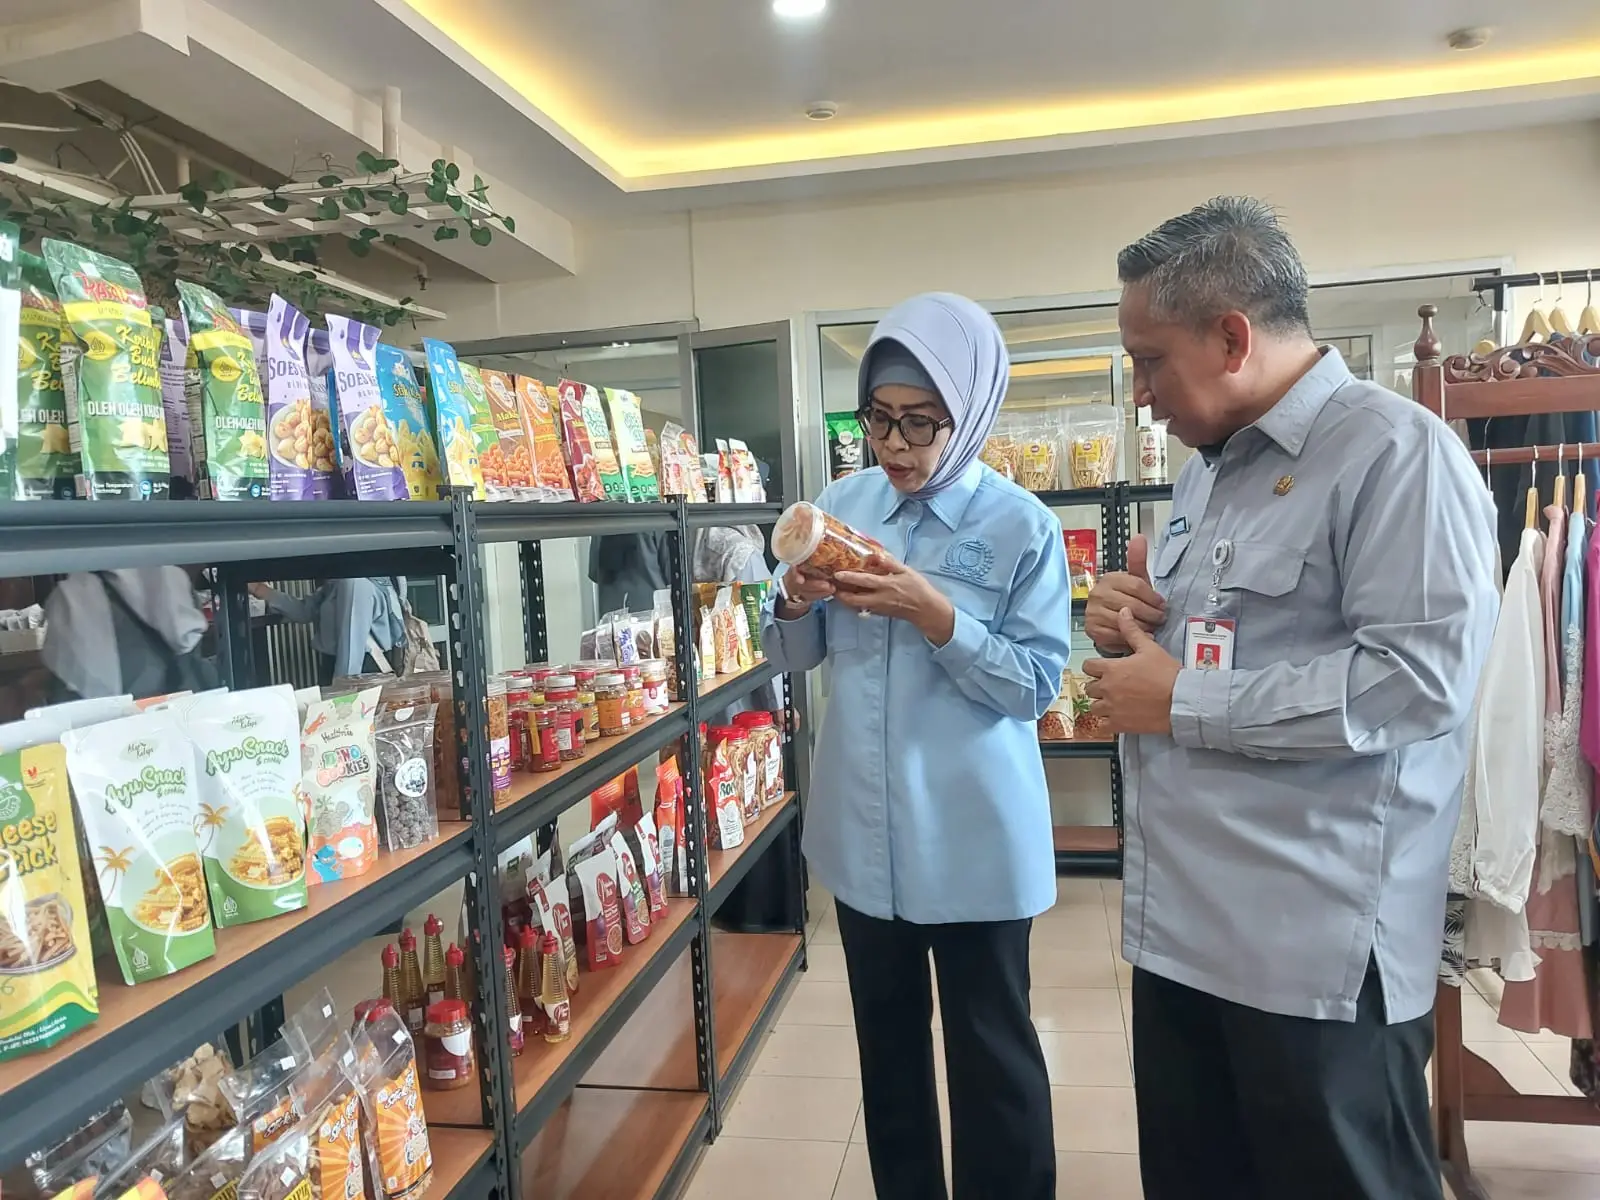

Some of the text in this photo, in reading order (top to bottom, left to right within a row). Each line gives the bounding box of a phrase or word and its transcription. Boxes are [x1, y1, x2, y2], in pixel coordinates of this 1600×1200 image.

[39, 409, 65, 424] OLEH
[87, 401, 117, 417] OLEH
[119, 401, 143, 417] OLEH
[215, 416, 240, 429] OLEH
[205, 750, 243, 776] Ayu
[105, 784, 144, 815] Ayu
[0, 811, 57, 850] eese
